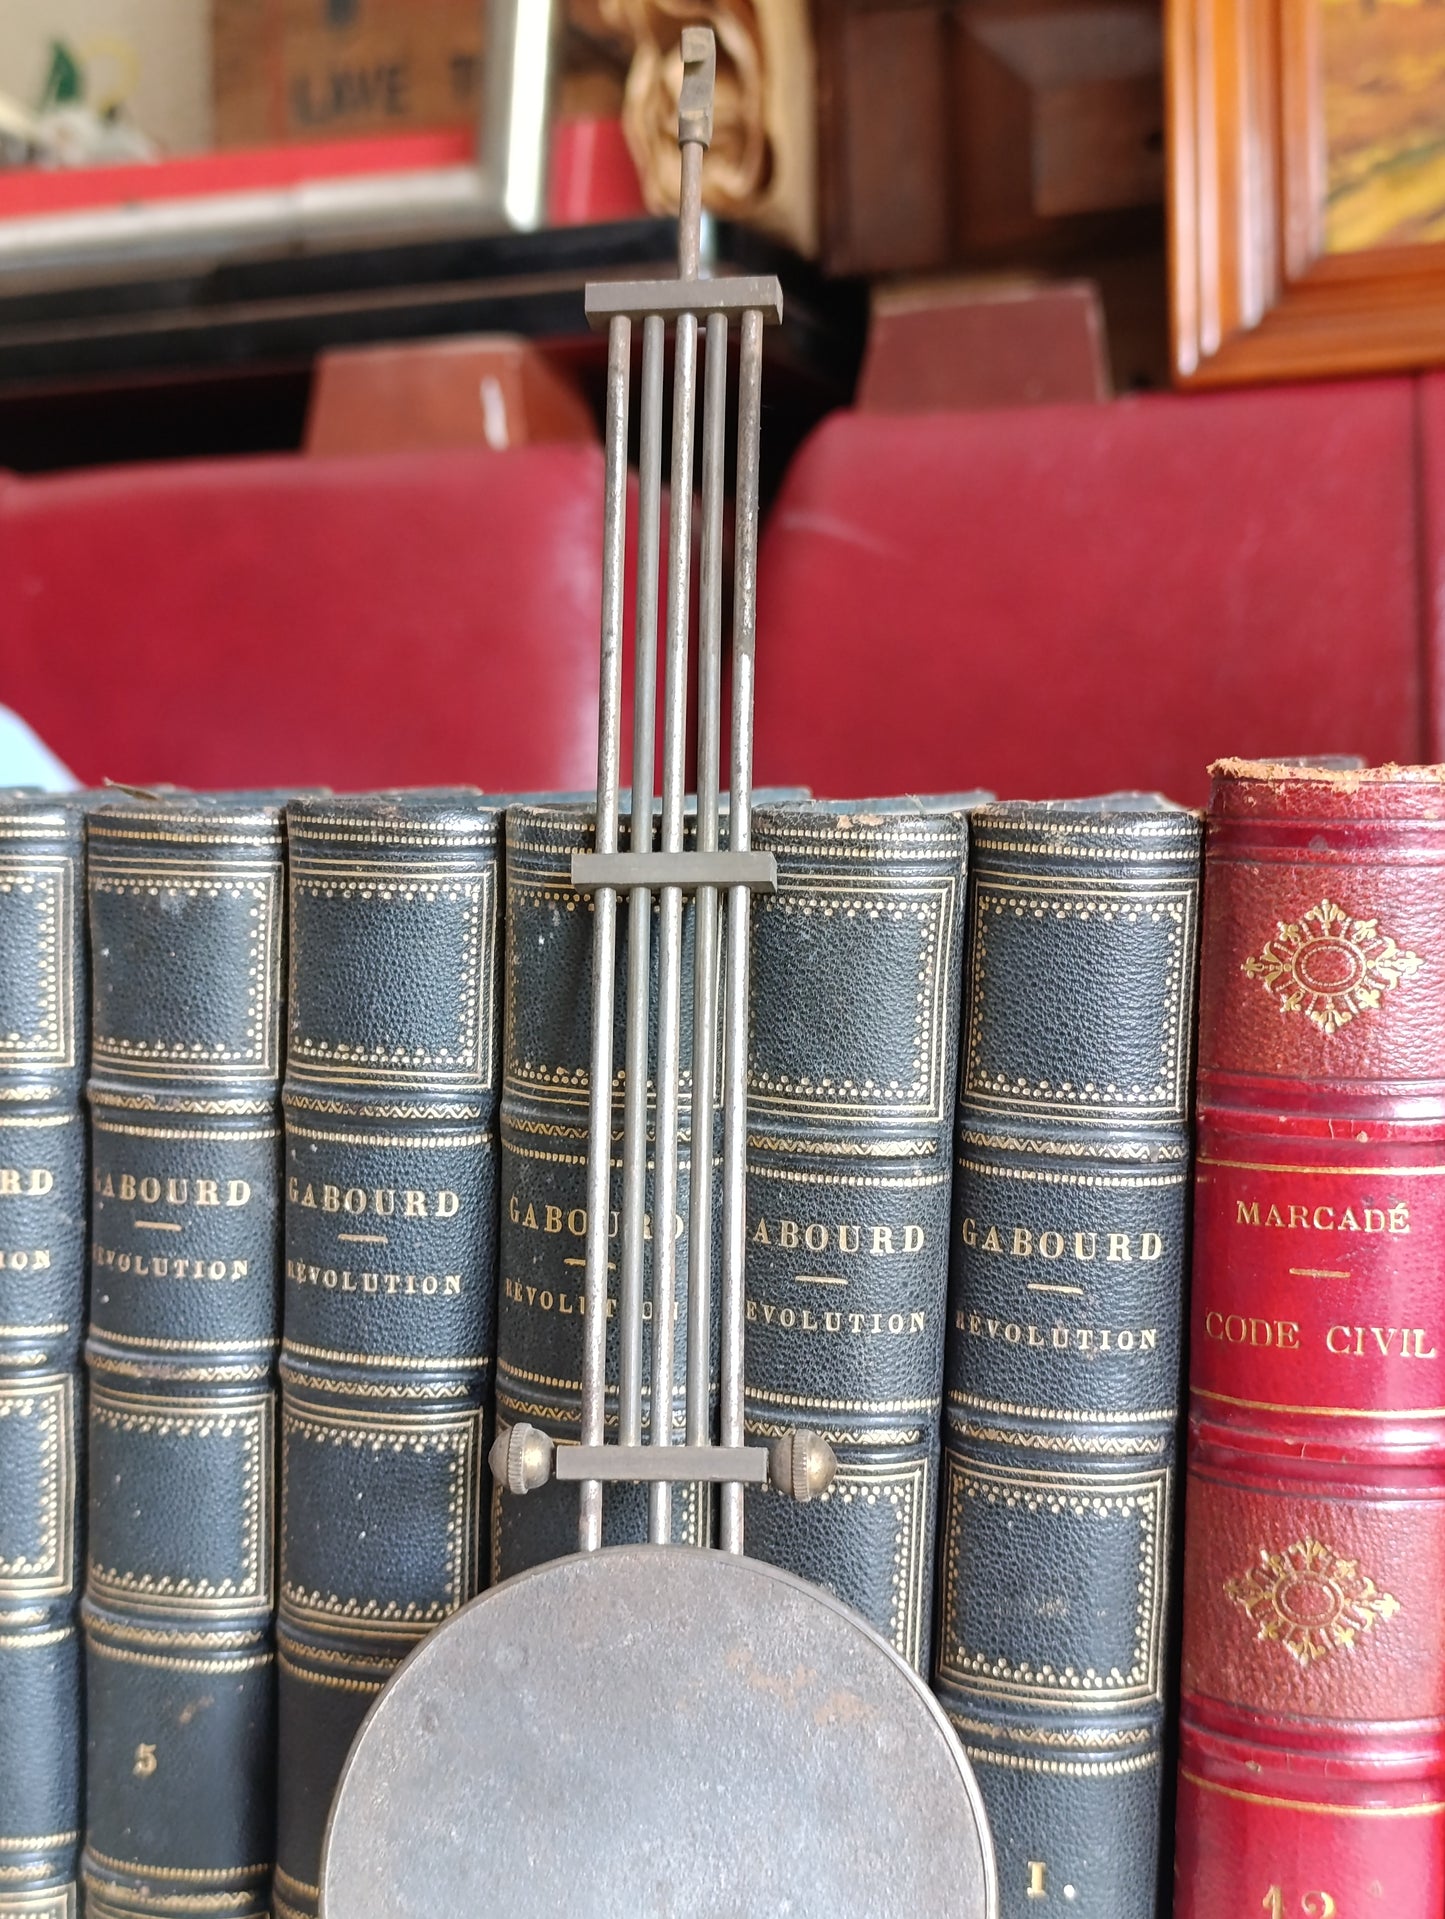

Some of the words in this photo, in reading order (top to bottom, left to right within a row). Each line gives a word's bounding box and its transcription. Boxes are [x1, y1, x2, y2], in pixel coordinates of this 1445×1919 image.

[288, 1176, 460, 1218] GABOURD
[752, 1217, 925, 1254] ABOURD
[1236, 1200, 1410, 1234] MARCADÉ
[962, 1217, 1162, 1262] GABOURD
[1206, 1311, 1300, 1349] CODE
[1326, 1325, 1436, 1359] CIVIL
[132, 1743, 158, 1779] 5
